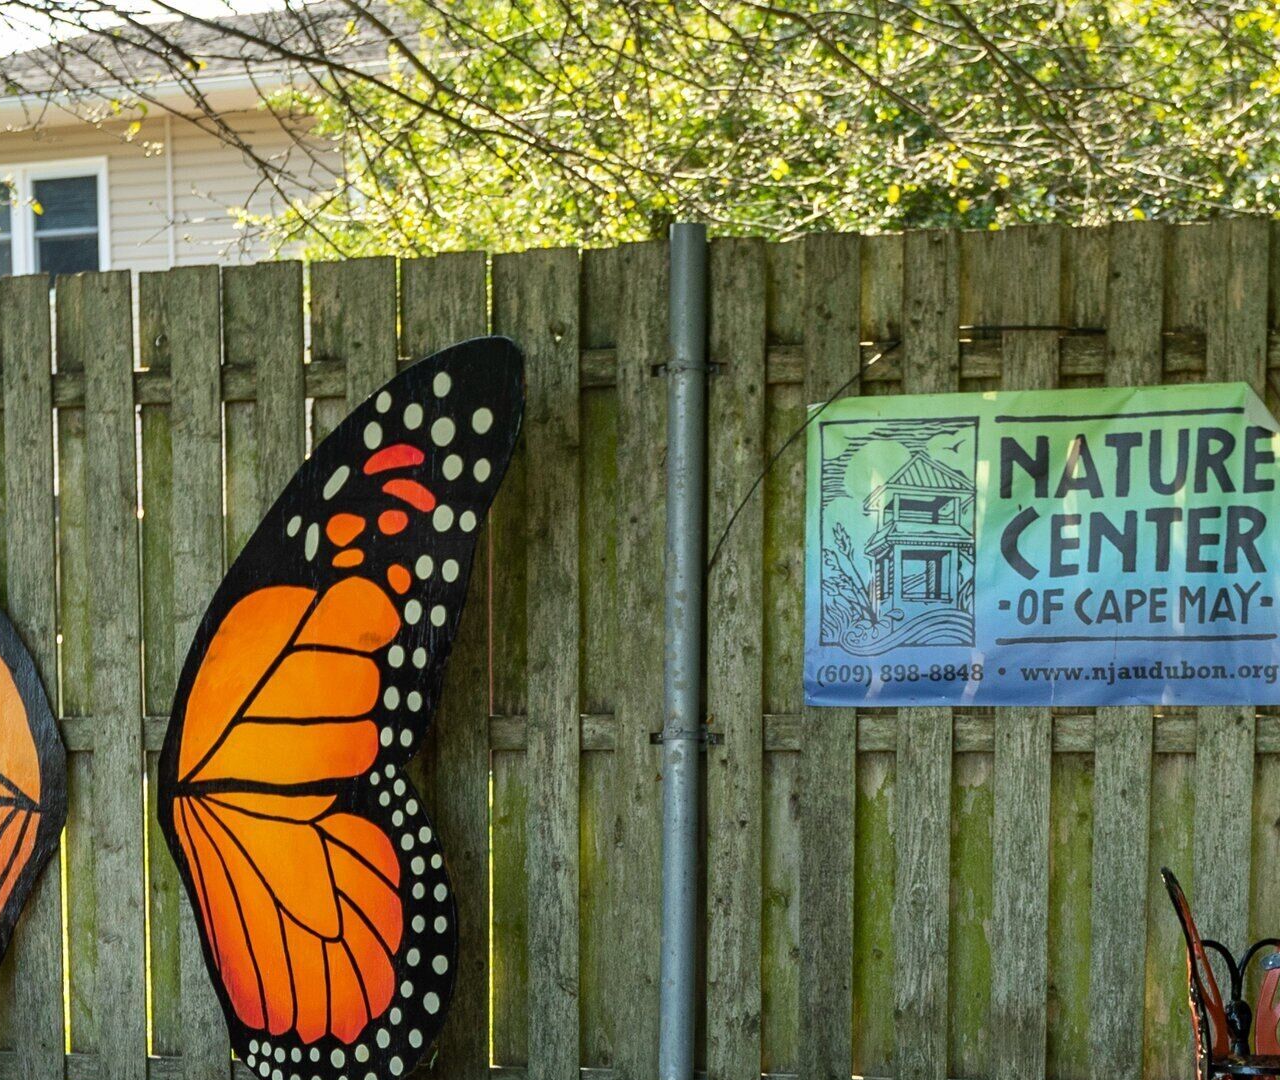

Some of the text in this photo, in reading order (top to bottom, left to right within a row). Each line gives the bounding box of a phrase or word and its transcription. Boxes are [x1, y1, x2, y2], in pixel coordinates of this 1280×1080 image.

[999, 427, 1276, 500] NATURE
[1000, 505, 1268, 581] CENTER
[1074, 587, 1168, 625] CAPE
[816, 661, 1280, 688] (609) 898-8848 www.njaudubon.org
